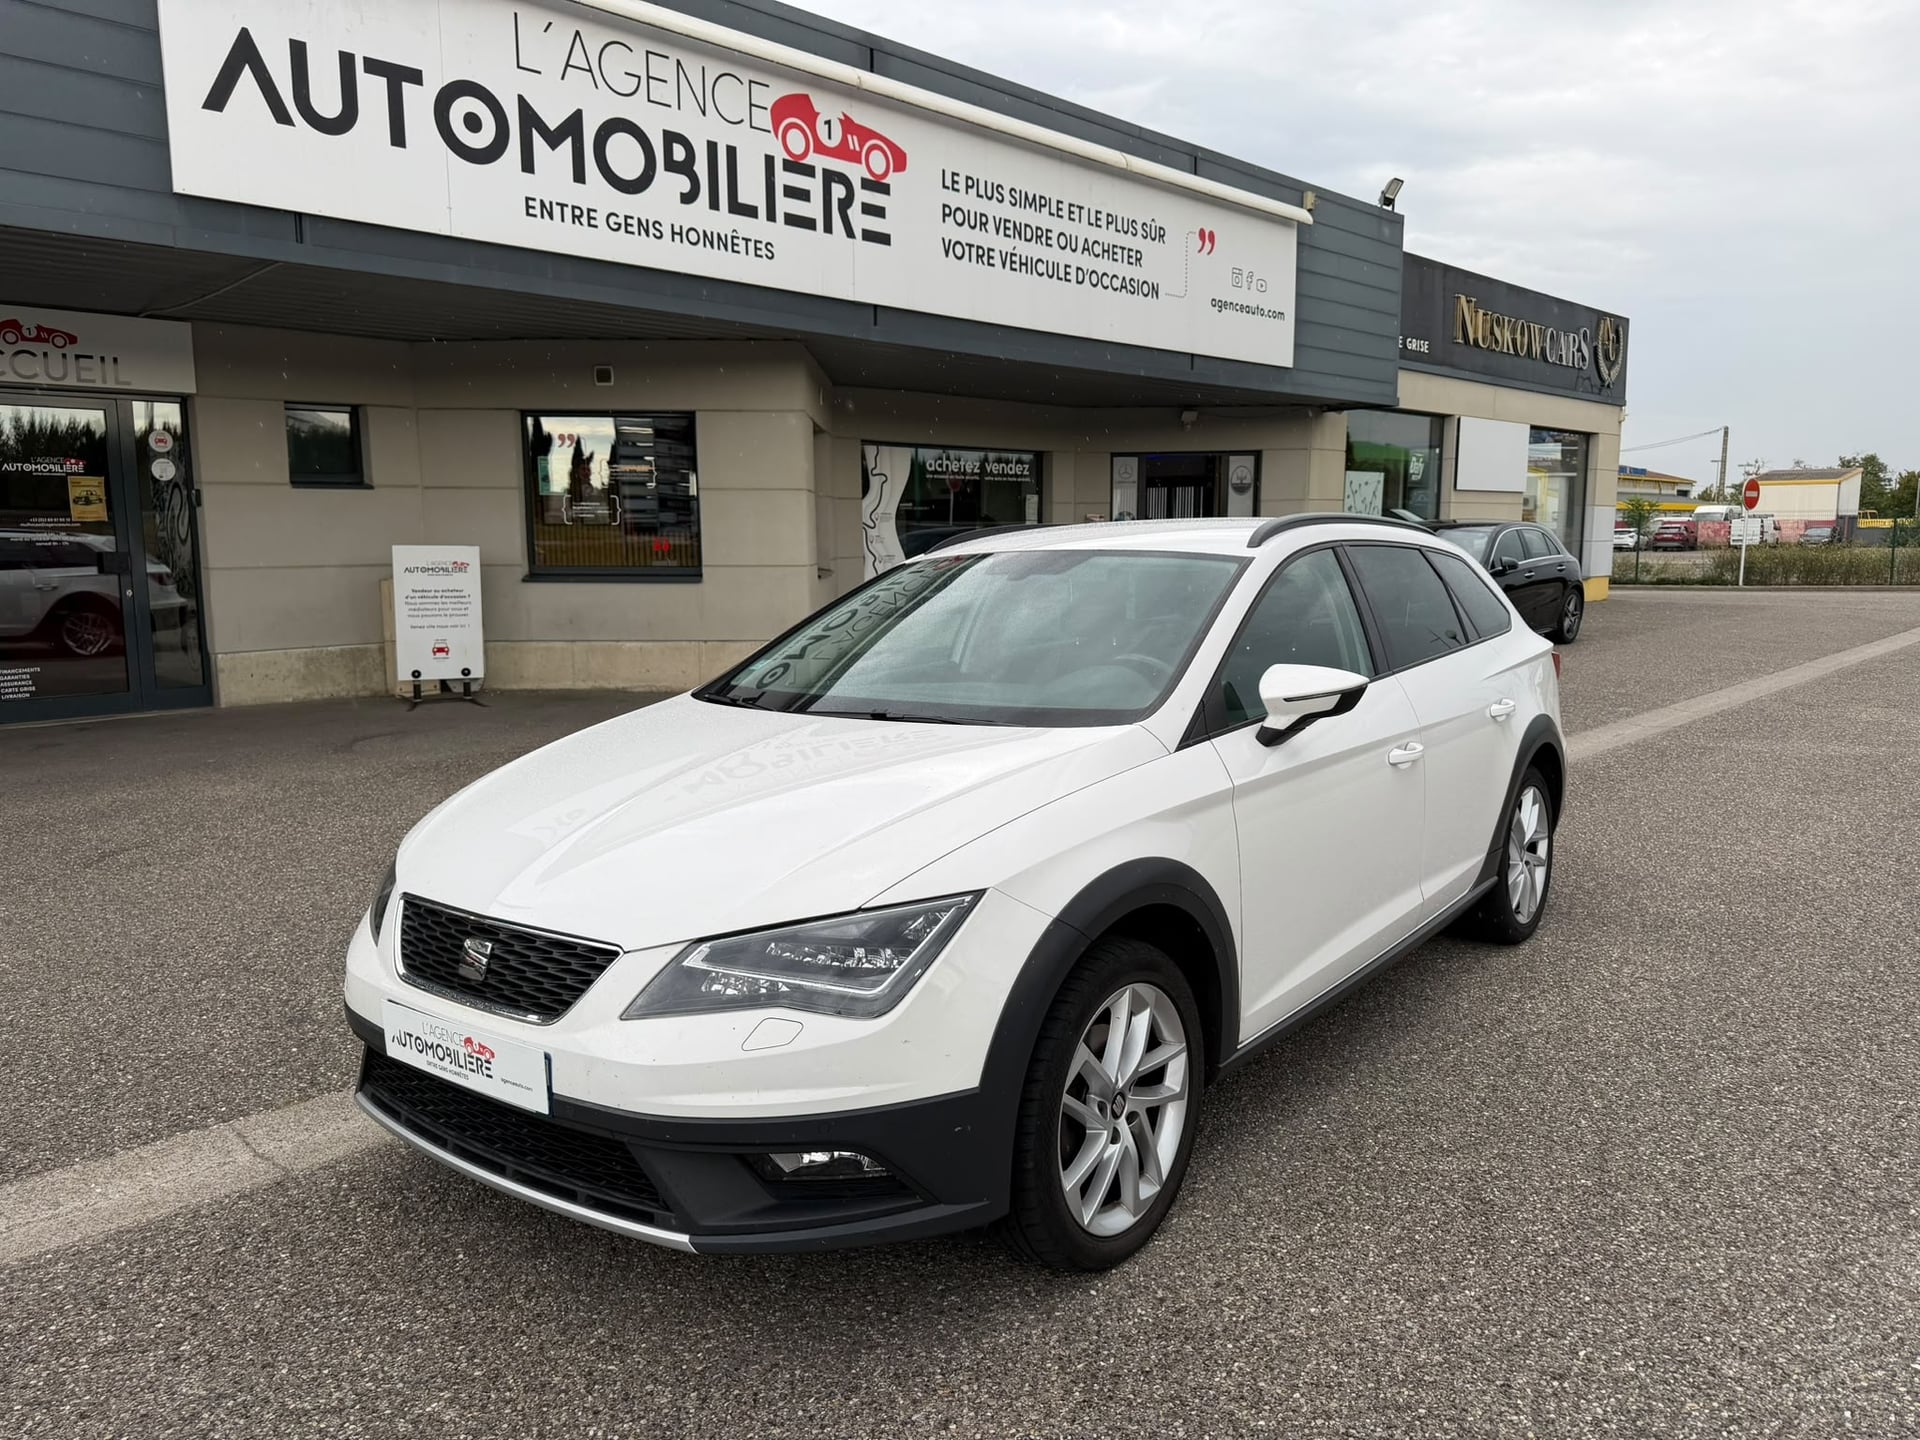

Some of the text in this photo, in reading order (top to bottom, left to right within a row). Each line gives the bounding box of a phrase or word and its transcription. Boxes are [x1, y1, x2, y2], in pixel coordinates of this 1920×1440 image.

[514, 12, 771, 133] L'AGENCE
[525, 196, 775, 260] ENTRE GENS HONNÊTES
[941, 169, 1166, 245] LE PLUS SIMPLE ET LE PLUS SÛR
[942, 204, 1143, 268] POUR VENDRE OU ACHETER
[942, 237, 1160, 300] VOTRE VÉHICULE D'OCCASION
[1210, 297, 1286, 322] agenceauto.com
[1406, 337, 1430, 353] GRISE
[926, 453, 980, 473] achetez
[985, 457, 1030, 476] vendez
[422, 1022, 464, 1047] L'AGENCE
